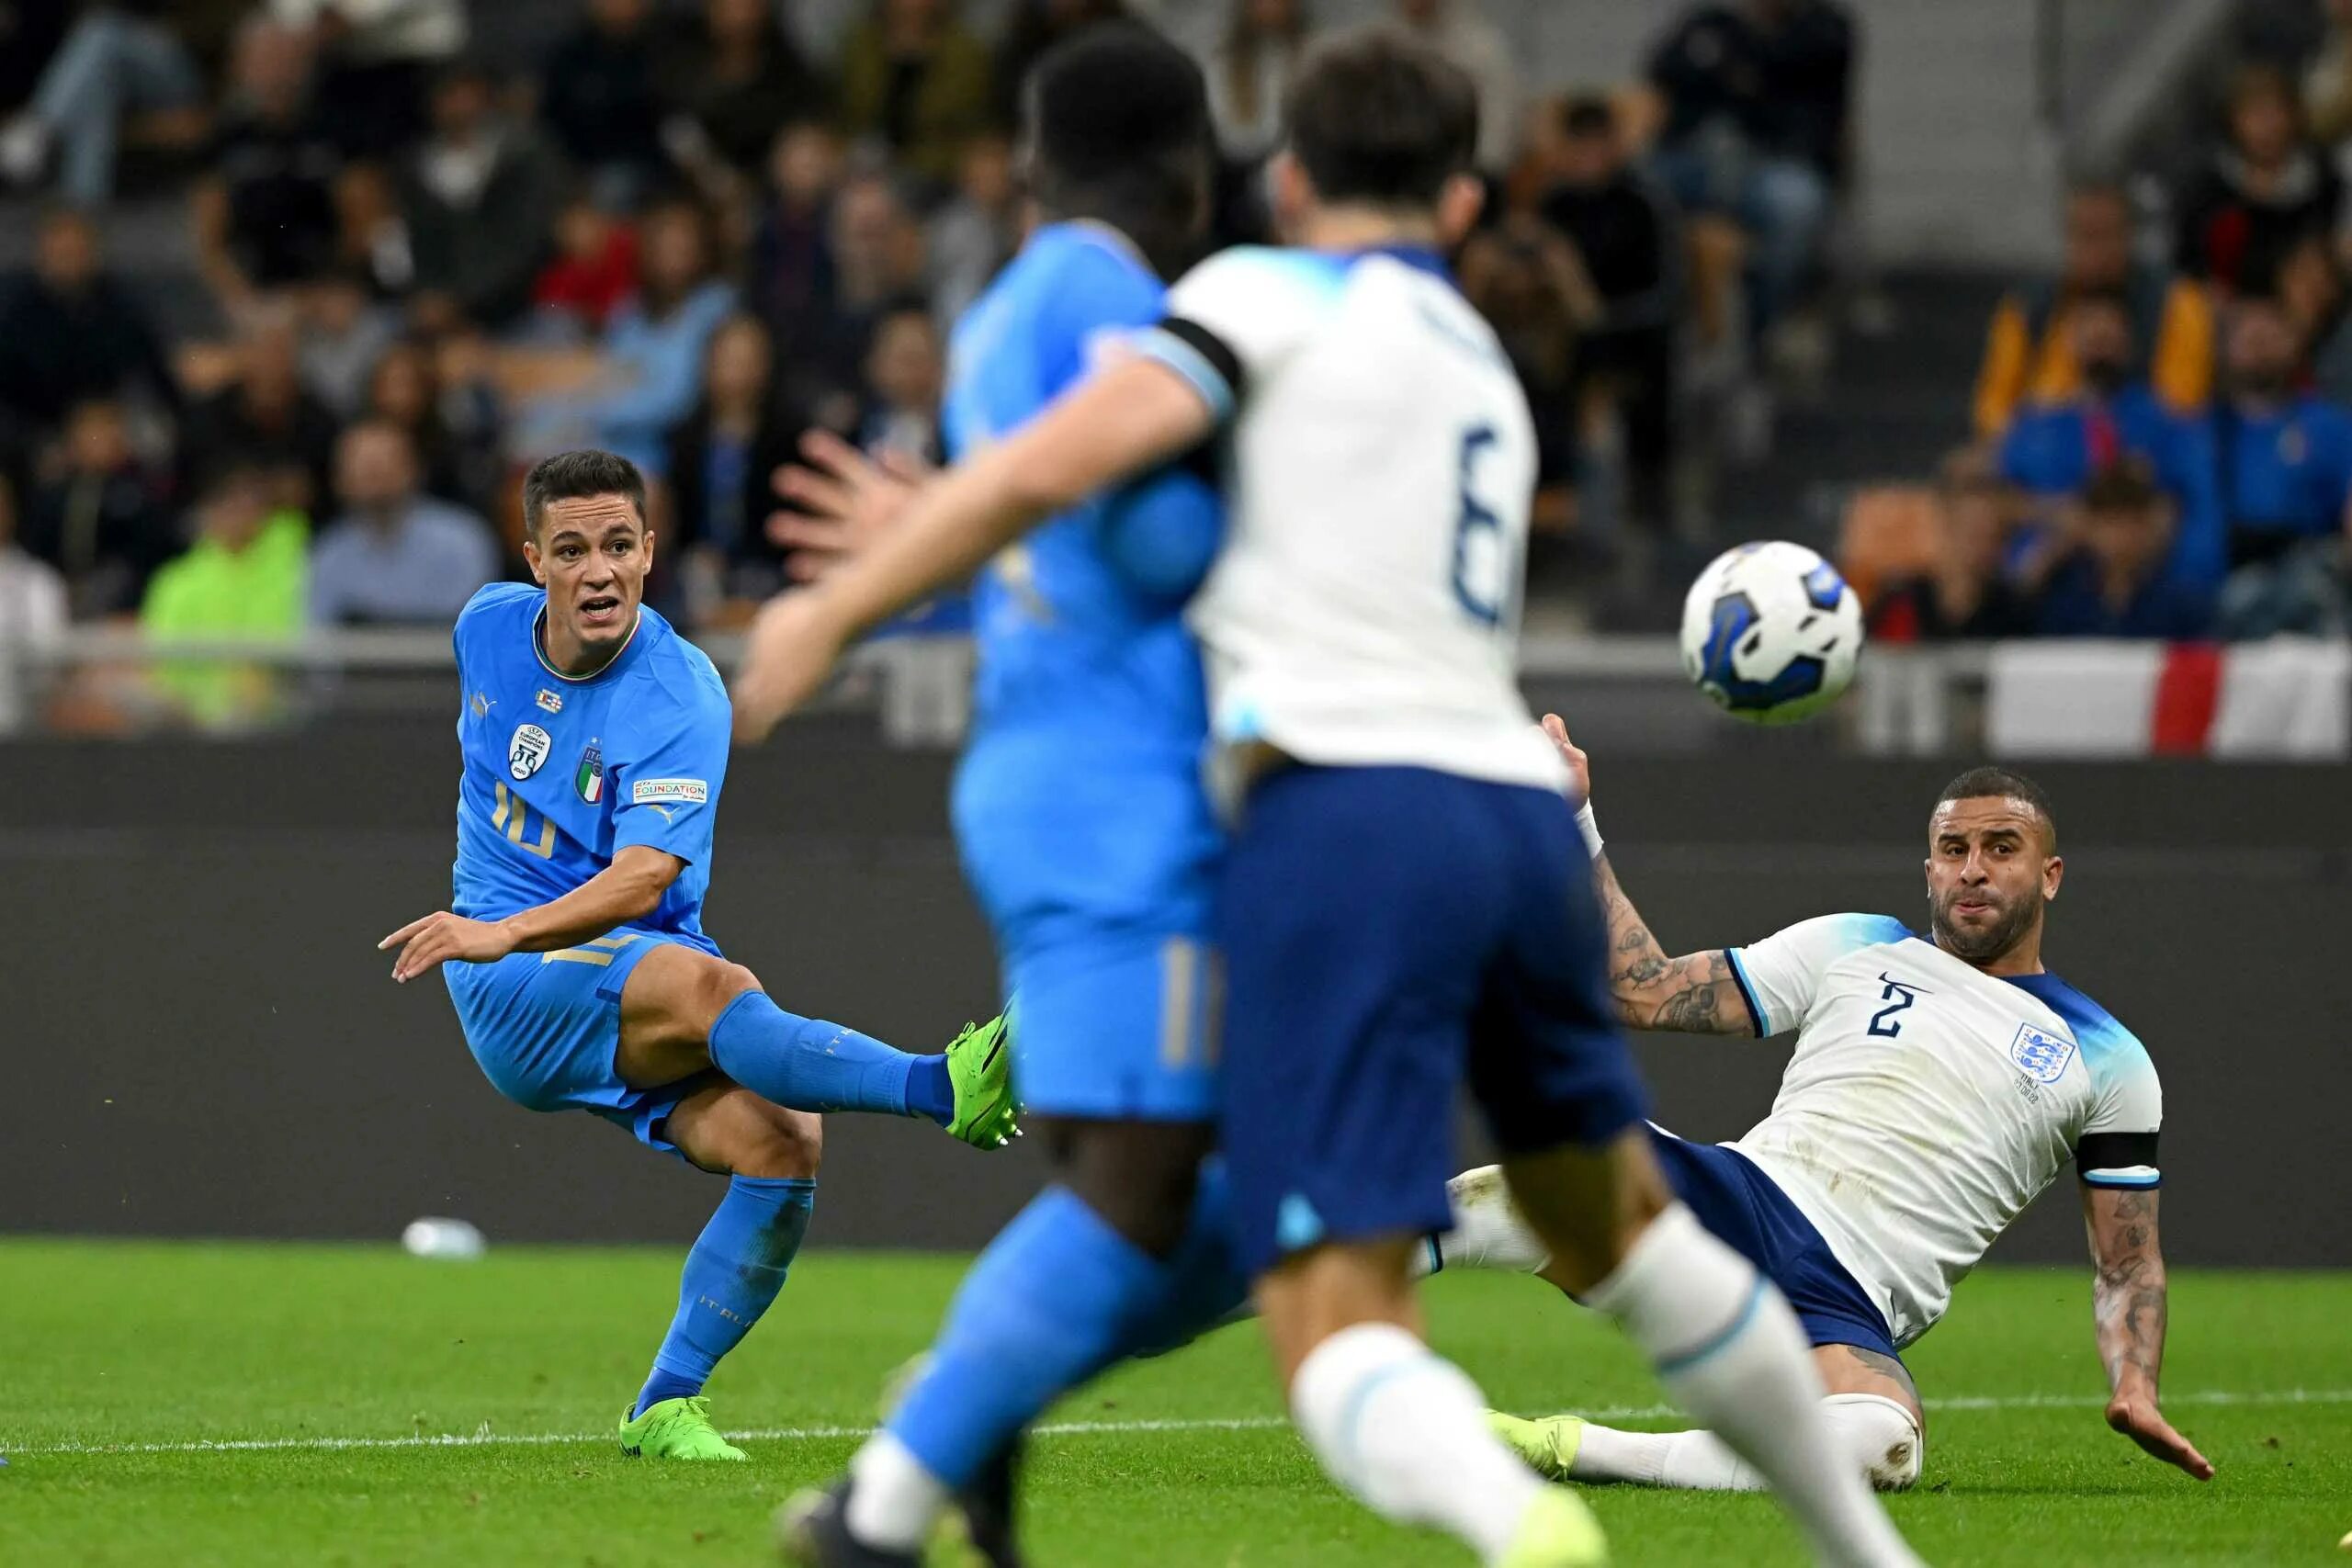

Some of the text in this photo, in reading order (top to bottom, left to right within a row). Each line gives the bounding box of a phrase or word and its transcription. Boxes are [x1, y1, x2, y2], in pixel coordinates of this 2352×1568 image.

[1451, 423, 1503, 628] 6
[492, 781, 557, 859] 10
[635, 784, 706, 795] FOUNDATION
[1867, 983, 1915, 1038] 2
